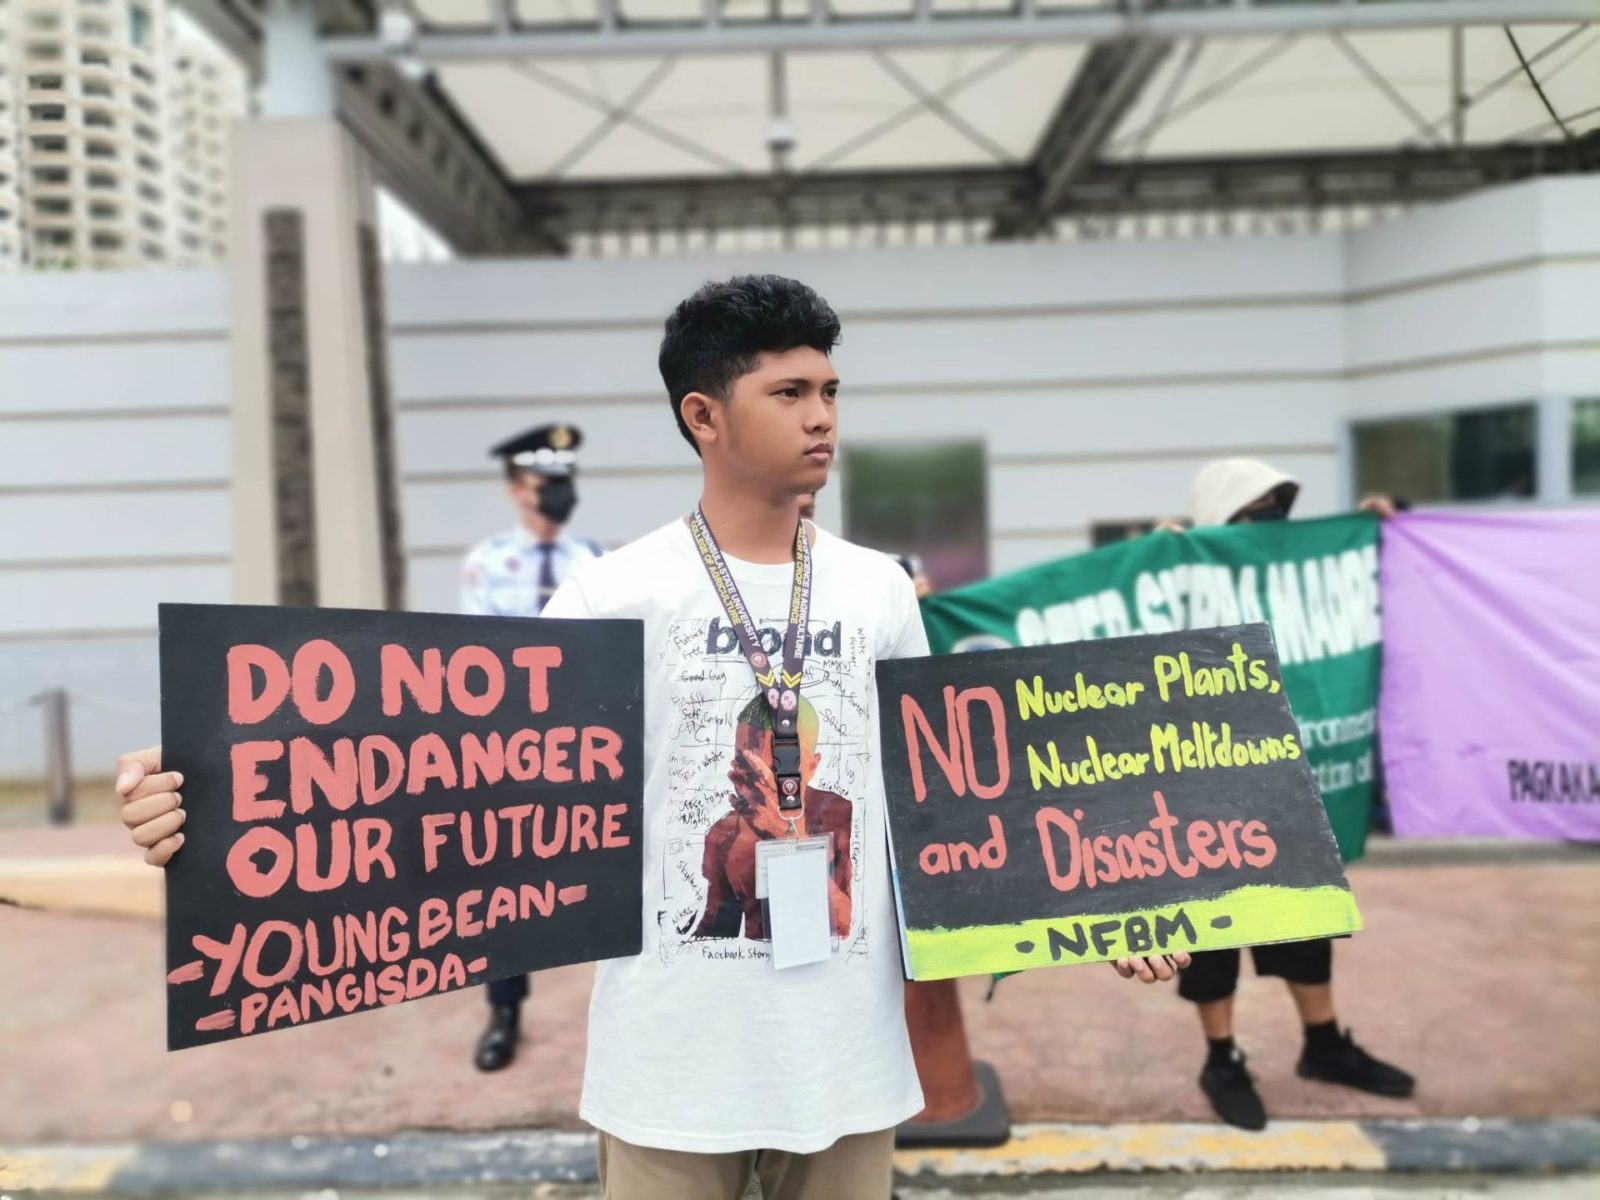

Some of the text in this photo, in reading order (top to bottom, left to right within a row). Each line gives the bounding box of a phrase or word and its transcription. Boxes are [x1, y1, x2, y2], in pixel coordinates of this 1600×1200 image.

[690, 520, 741, 626] COLLEGE OF AGRICULTURE
[719, 567, 736, 595] STATE
[731, 593, 761, 647] UNIVERSITY
[789, 585, 802, 625] SCIENCE
[795, 561, 804, 586] CROP
[794, 597, 809, 659] AGRICULTURE
[226, 638, 563, 725] DO NOT
[1015, 642, 1281, 721] Nuclear Plants,
[230, 726, 624, 823] ENDANGER
[901, 685, 1011, 803] NO
[1026, 721, 1301, 792] Nuclear Meltdowns
[226, 803, 630, 898] OUR FUTURE
[918, 790, 1278, 892] and Disasters
[702, 946, 745, 960] Facebook
[1046, 908, 1198, 962] NFBM
